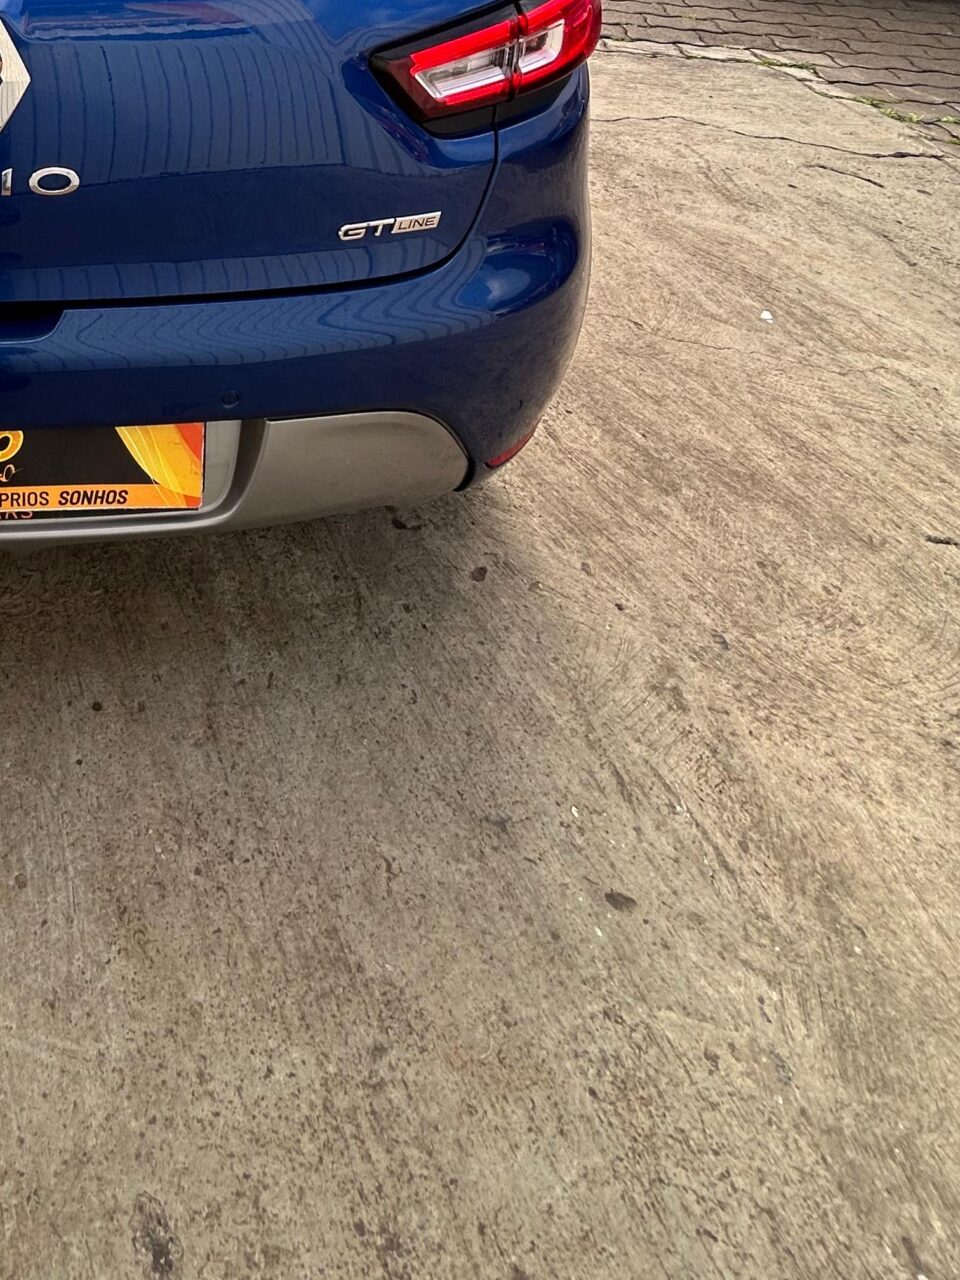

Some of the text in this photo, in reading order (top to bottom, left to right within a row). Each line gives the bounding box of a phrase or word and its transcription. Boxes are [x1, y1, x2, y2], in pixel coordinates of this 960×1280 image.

[338, 212, 441, 241] GT LINE
[58, 489, 129, 506] SONHOS
